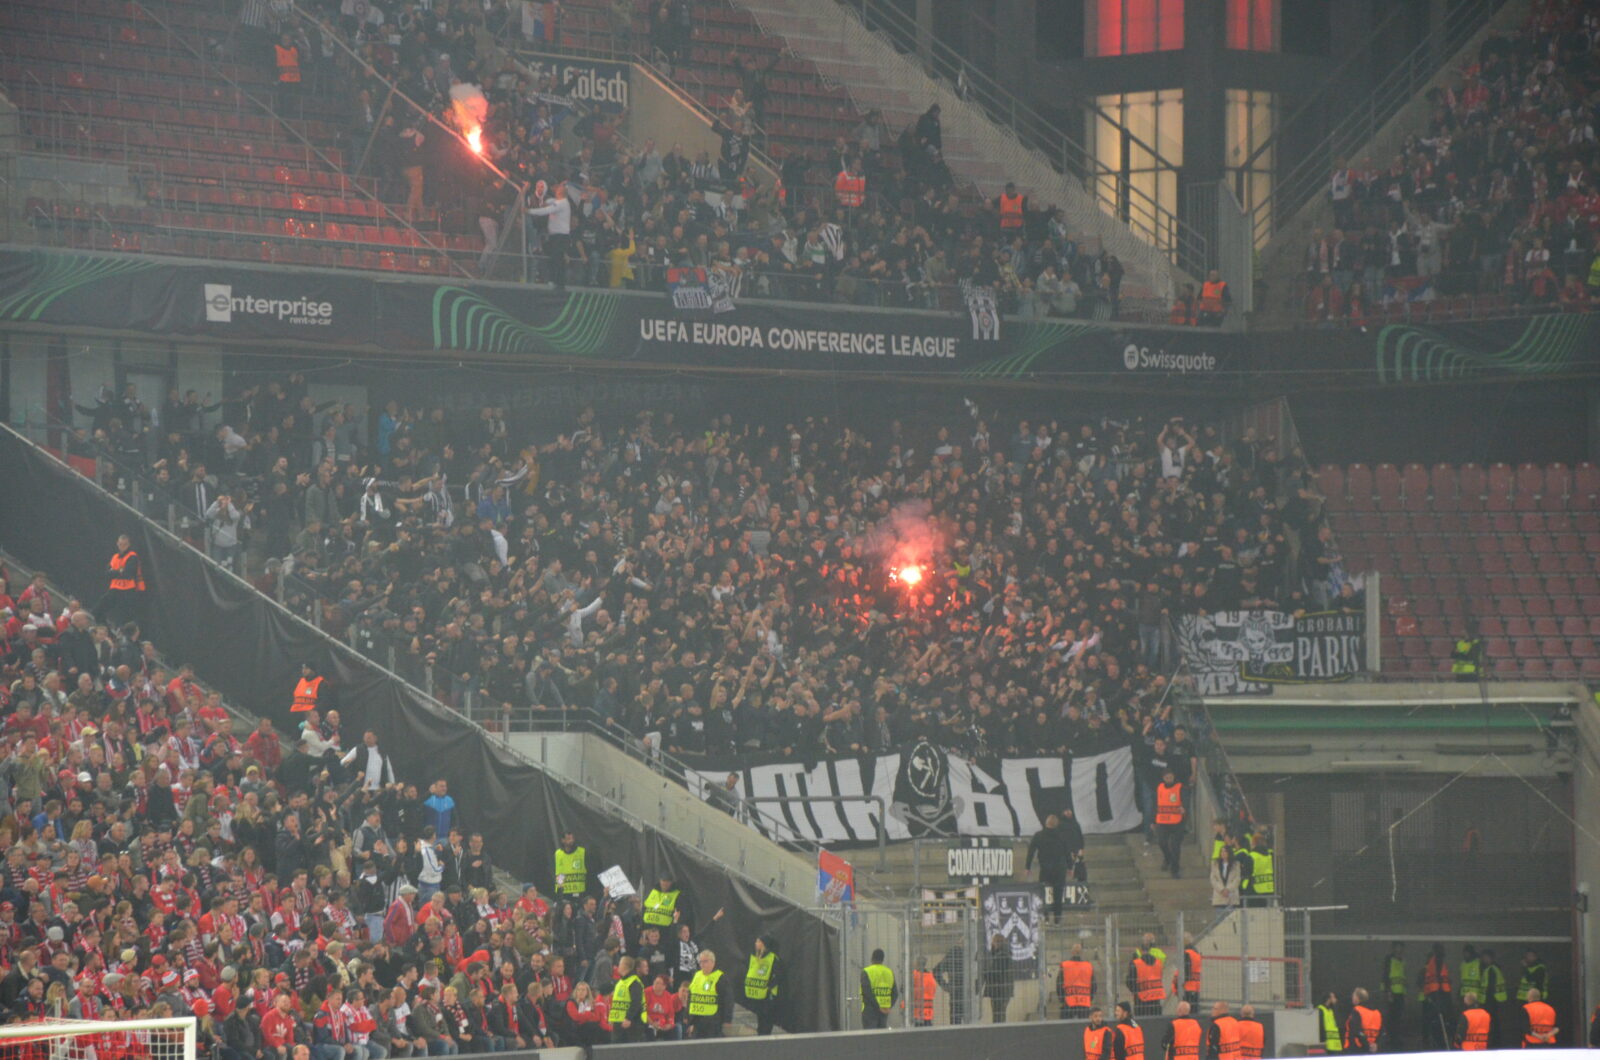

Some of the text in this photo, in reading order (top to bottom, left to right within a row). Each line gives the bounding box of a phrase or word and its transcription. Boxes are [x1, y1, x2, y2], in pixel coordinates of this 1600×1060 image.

[206, 293, 333, 320] enterprise
[289, 316, 333, 325] rent-a-car
[640, 318, 956, 358] UEFA EUROPA CONFERENCE LEAGUE
[1140, 347, 1216, 374] Swissquote
[1296, 616, 1361, 633] GROBARI
[1297, 635, 1360, 677] PARIS
[948, 848, 1014, 876] COMMANDO
